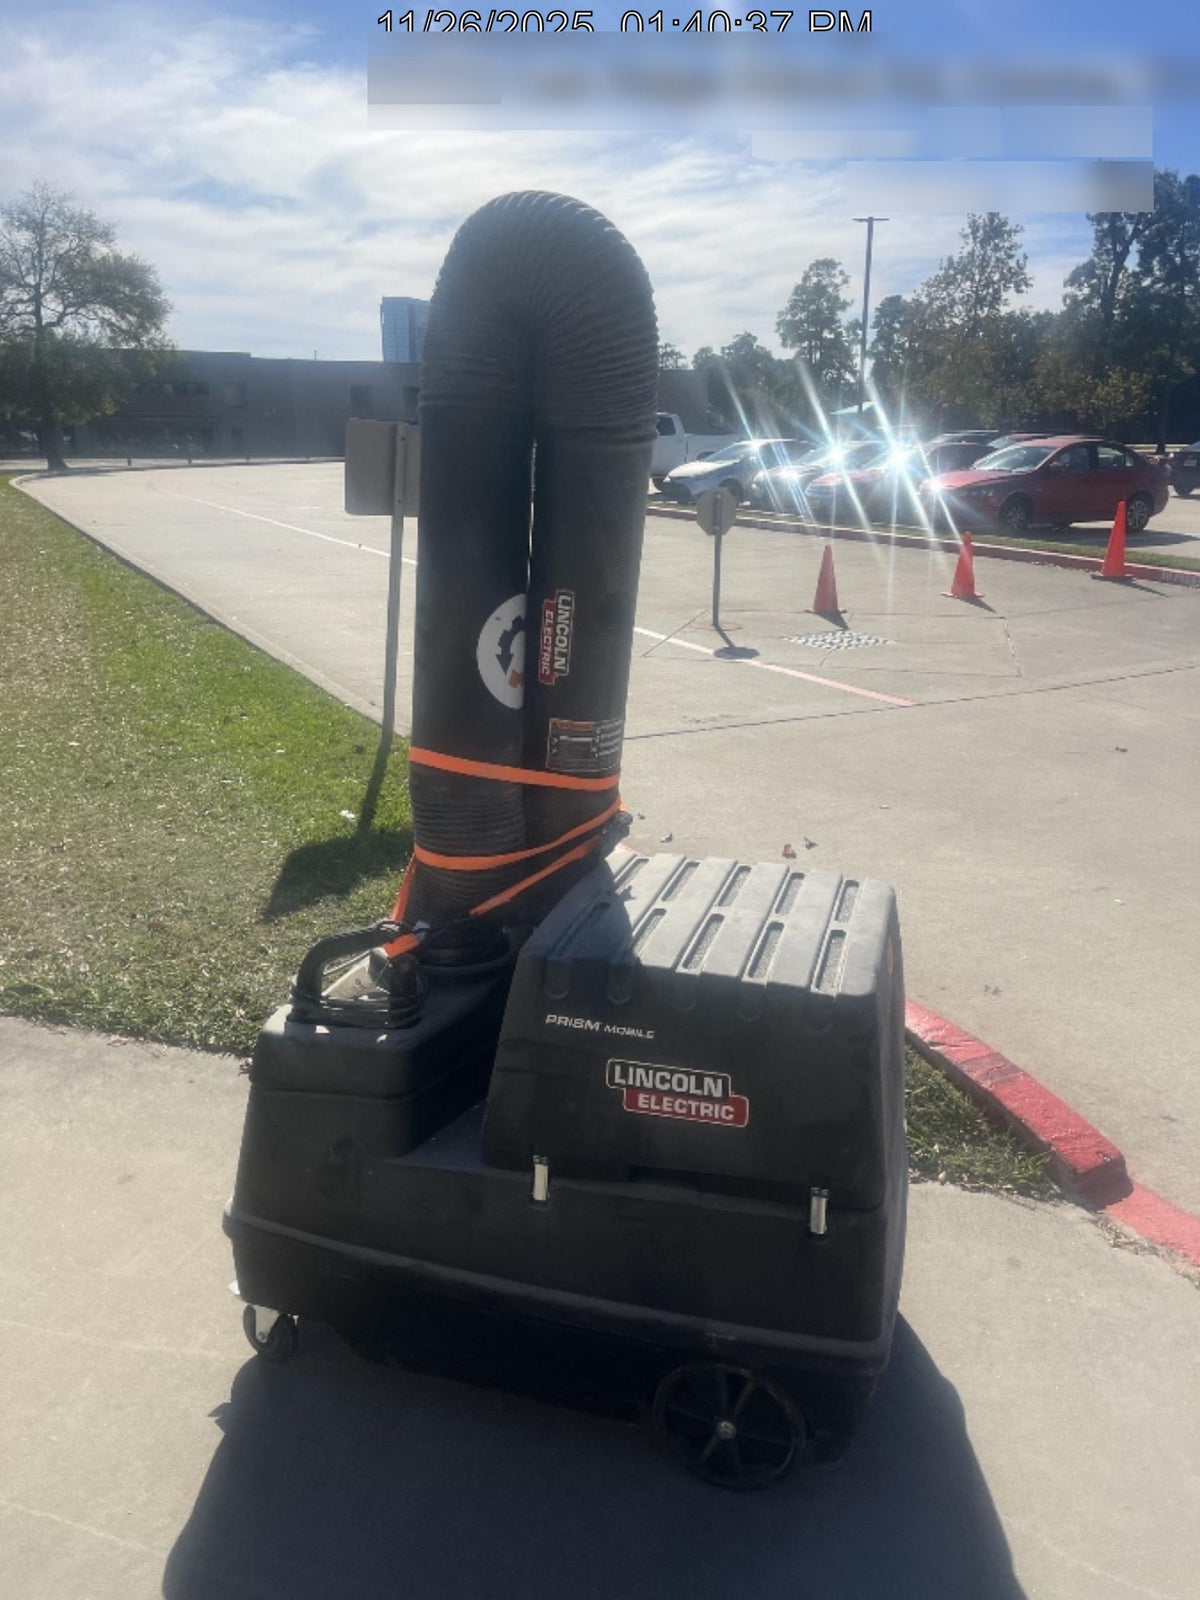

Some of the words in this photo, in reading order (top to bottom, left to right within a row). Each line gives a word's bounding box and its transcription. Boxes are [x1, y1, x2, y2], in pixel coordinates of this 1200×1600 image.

[541, 609, 554, 675] ELECTRIC
[553, 594, 572, 673] LINCOLN
[544, 1013, 602, 1032] PRISM
[603, 1023, 656, 1040] MOBILE
[614, 1063, 724, 1099] LINCOLN
[637, 1093, 736, 1121] ELECTRIC
